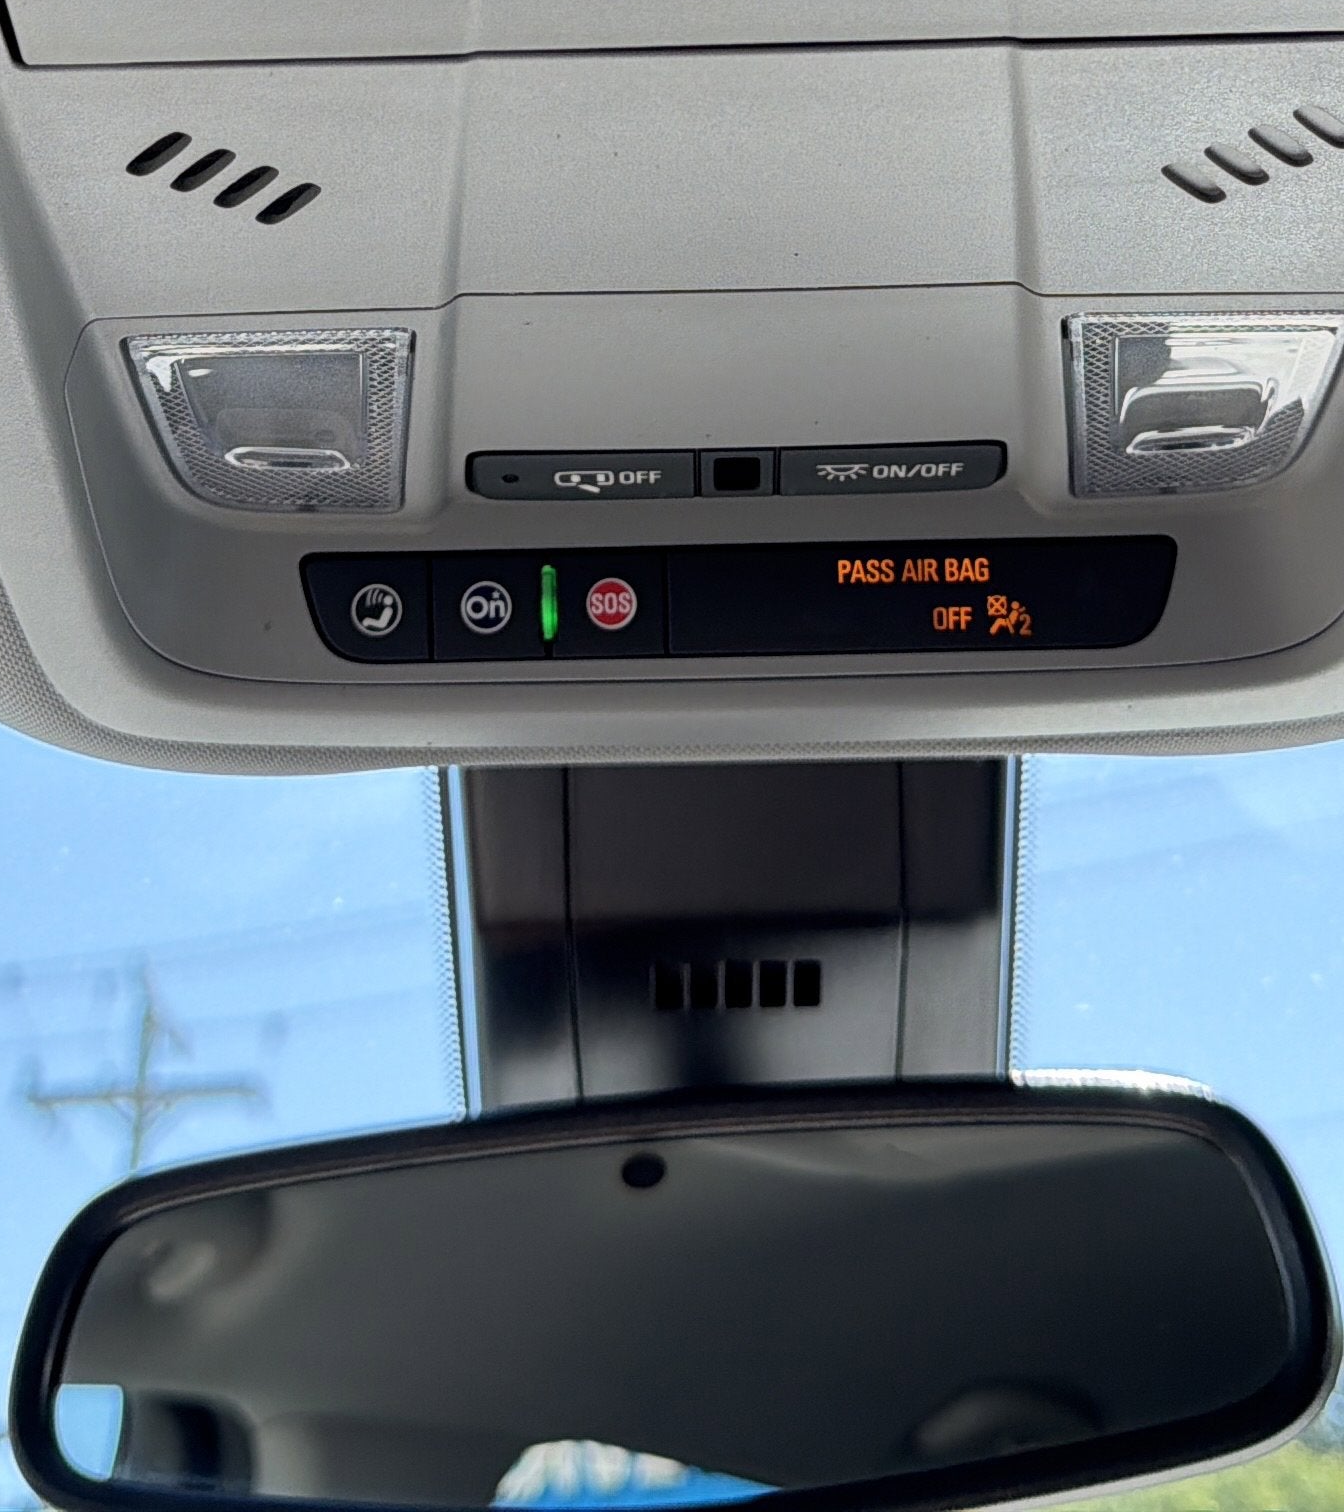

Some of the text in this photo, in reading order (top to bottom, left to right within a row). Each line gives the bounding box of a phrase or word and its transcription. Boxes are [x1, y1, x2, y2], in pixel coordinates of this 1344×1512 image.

[619, 471, 662, 485] OFF
[872, 462, 965, 479] ON/OFF
[837, 557, 991, 584] PASS AIR BAG
[591, 592, 633, 615] SOS
[932, 606, 973, 631] OFF
